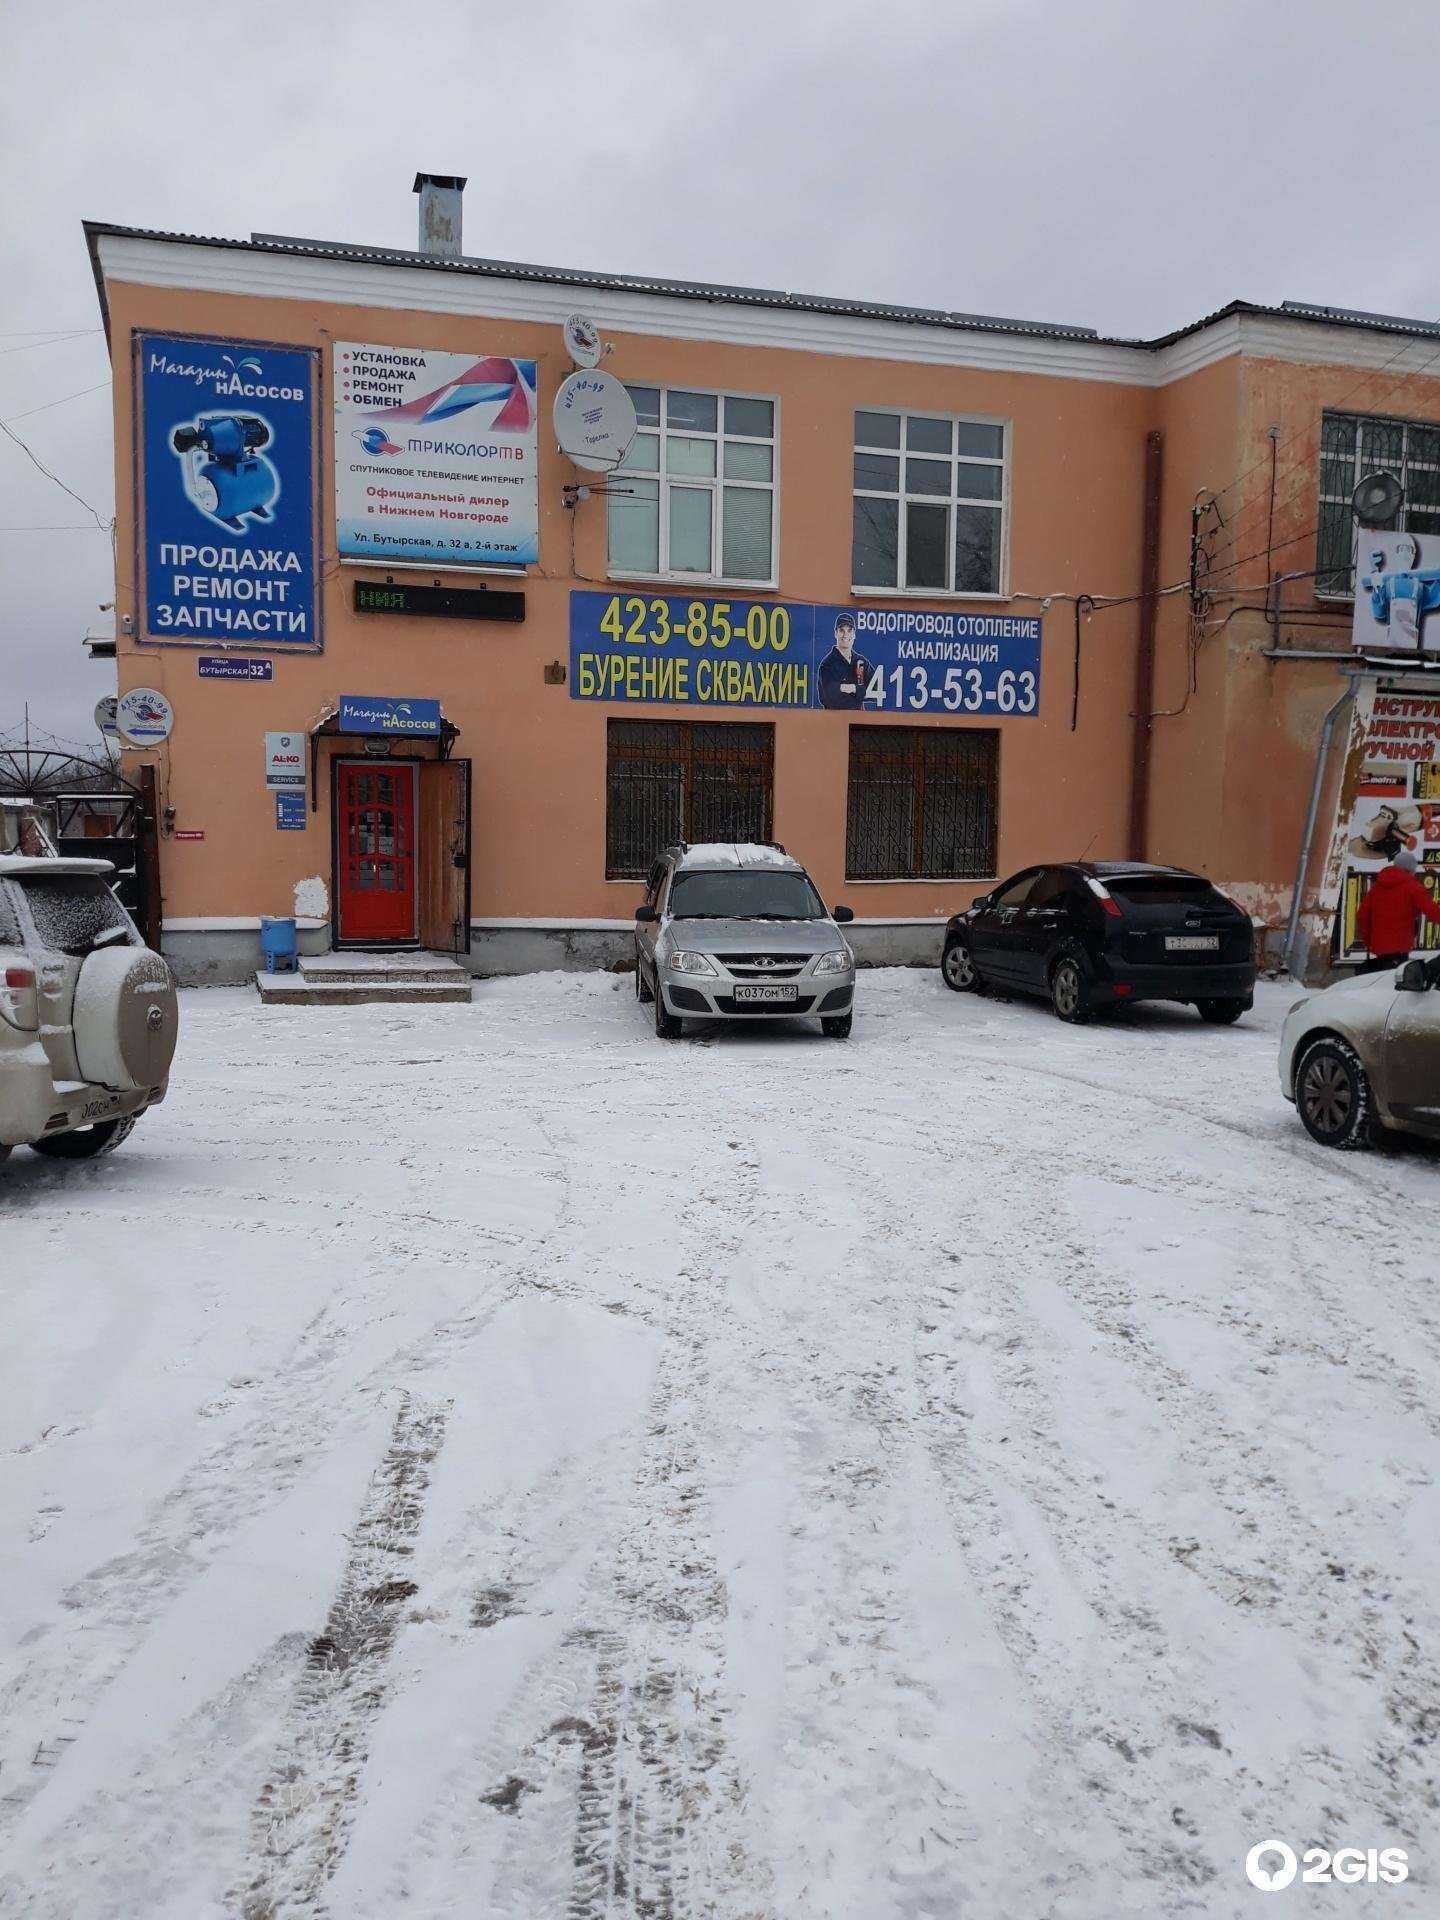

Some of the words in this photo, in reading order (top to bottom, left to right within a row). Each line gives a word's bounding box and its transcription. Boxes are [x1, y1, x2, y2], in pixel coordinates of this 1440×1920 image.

[150, 353, 228, 385] Магазин
[352, 350, 426, 368] УСТАНОВКА
[353, 366, 417, 381] ПРОДАЖА
[353, 380, 404, 394] РЕМОНТ
[353, 394, 402, 408] ОБМЕН
[350, 464, 415, 477] СПУТНИКОВОЕ
[417, 469, 479, 482] ТЕЛЕВИДЕНИЕ
[481, 475, 524, 485] ИНТЕРНЕТ
[366, 486, 465, 504] Официальный
[469, 494, 509, 508] дилер
[367, 506, 374, 514] в
[379, 505, 435, 518] Нижнем
[439, 509, 509, 524] Новгороде
[354, 532, 371, 545] Ул.
[373, 533, 433, 549] Бутырская,
[436, 540, 447, 549] д.
[450, 539, 462, 549] 32
[475, 541, 492, 551] 2-й
[493, 543, 518, 552] этаж
[160, 543, 302, 573] ПРОДАЖА
[173, 575, 290, 602] РЕМОНТ
[157, 604, 306, 633] ЗАПЧАСТИ
[600, 596, 790, 651] 423-85-00
[856, 611, 954, 638] ВОДОПРОВОД
[957, 617, 1039, 639] ОТОПЛЕНИЕ
[898, 640, 999, 665] КАНАЛИЗАЦИЯ
[200, 666, 249, 675] БУТЫРСКАЯ
[579, 653, 689, 700] БУРЕНИЕ
[696, 659, 808, 704] СКВАЖИН
[865, 664, 1036, 712] 413-53-63
[343, 705, 390, 722] Магазин
